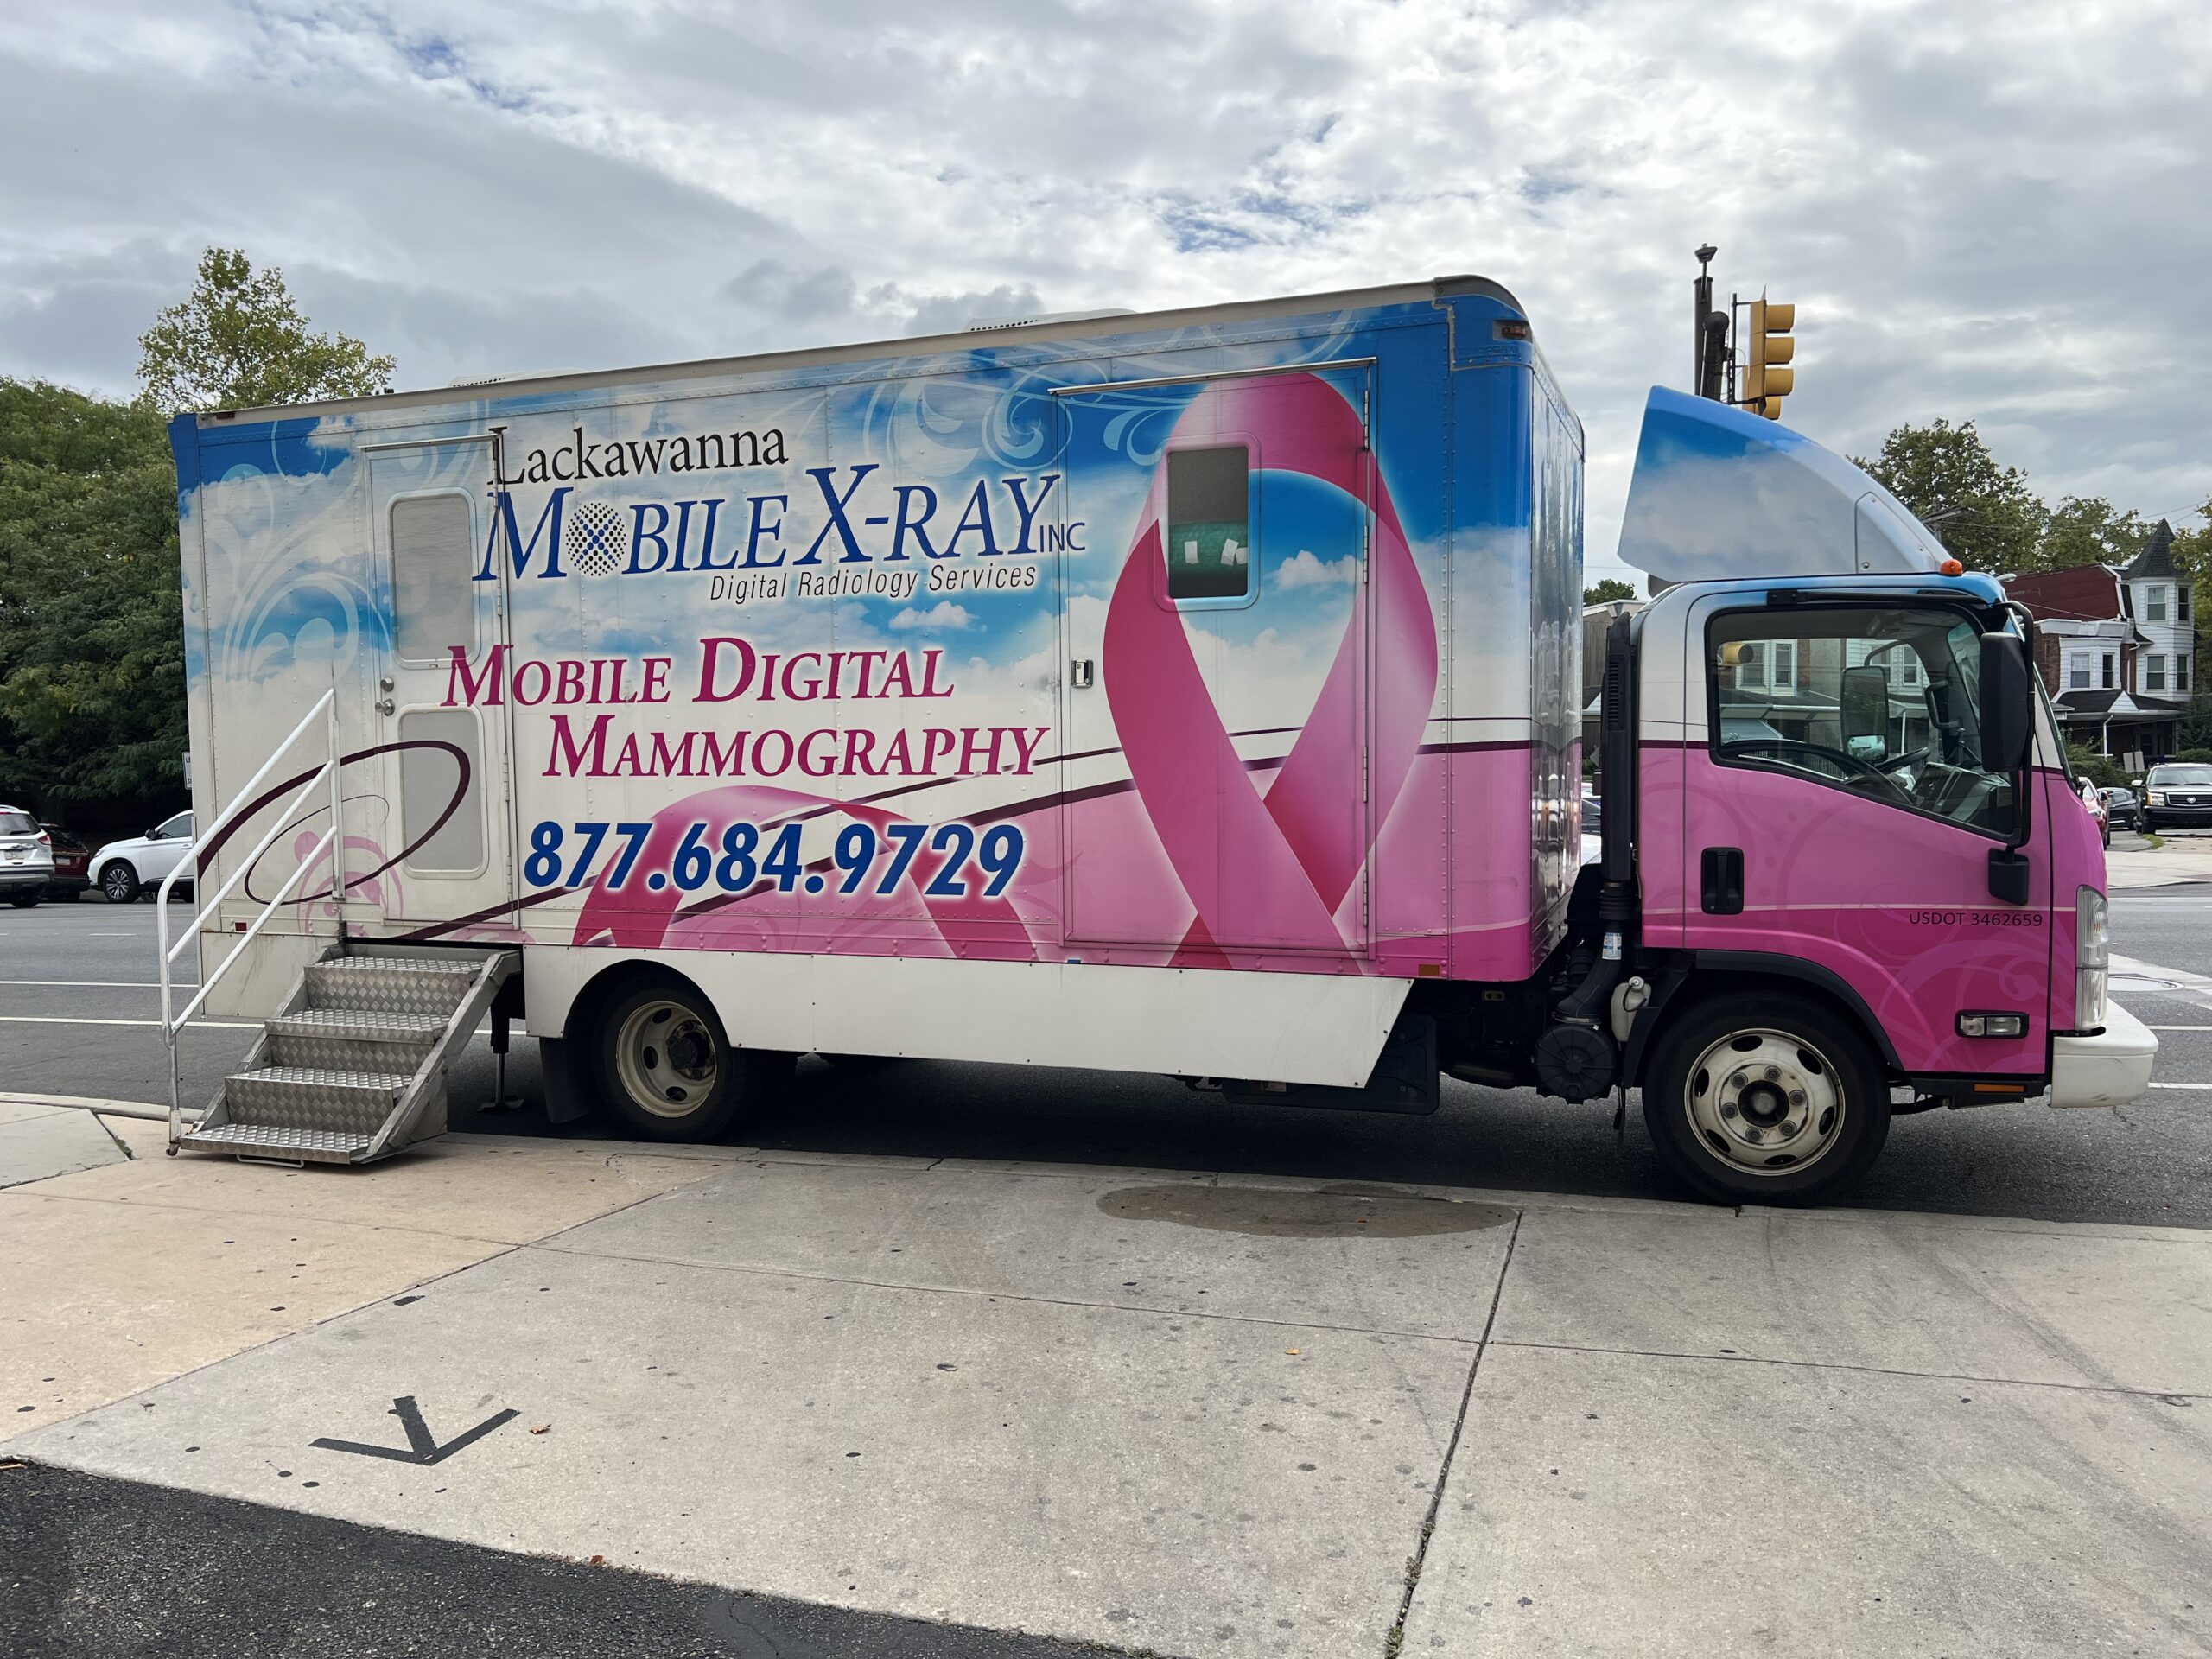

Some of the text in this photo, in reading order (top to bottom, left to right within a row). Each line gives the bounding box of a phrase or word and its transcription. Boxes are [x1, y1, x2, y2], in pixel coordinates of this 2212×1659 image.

[486, 426, 789, 486] Lackawanna
[792, 463, 1061, 566] X-RAY
[1039, 522, 1086, 553] INC
[709, 563, 1037, 605] Digital Radiology Services
[440, 636, 955, 708] MOBILE DIGITAL
[543, 714, 1051, 778] MAMMOGRAPHY
[523, 820, 1026, 897] 877.684.9729
[1909, 912, 2044, 927] USDOT 3462659
